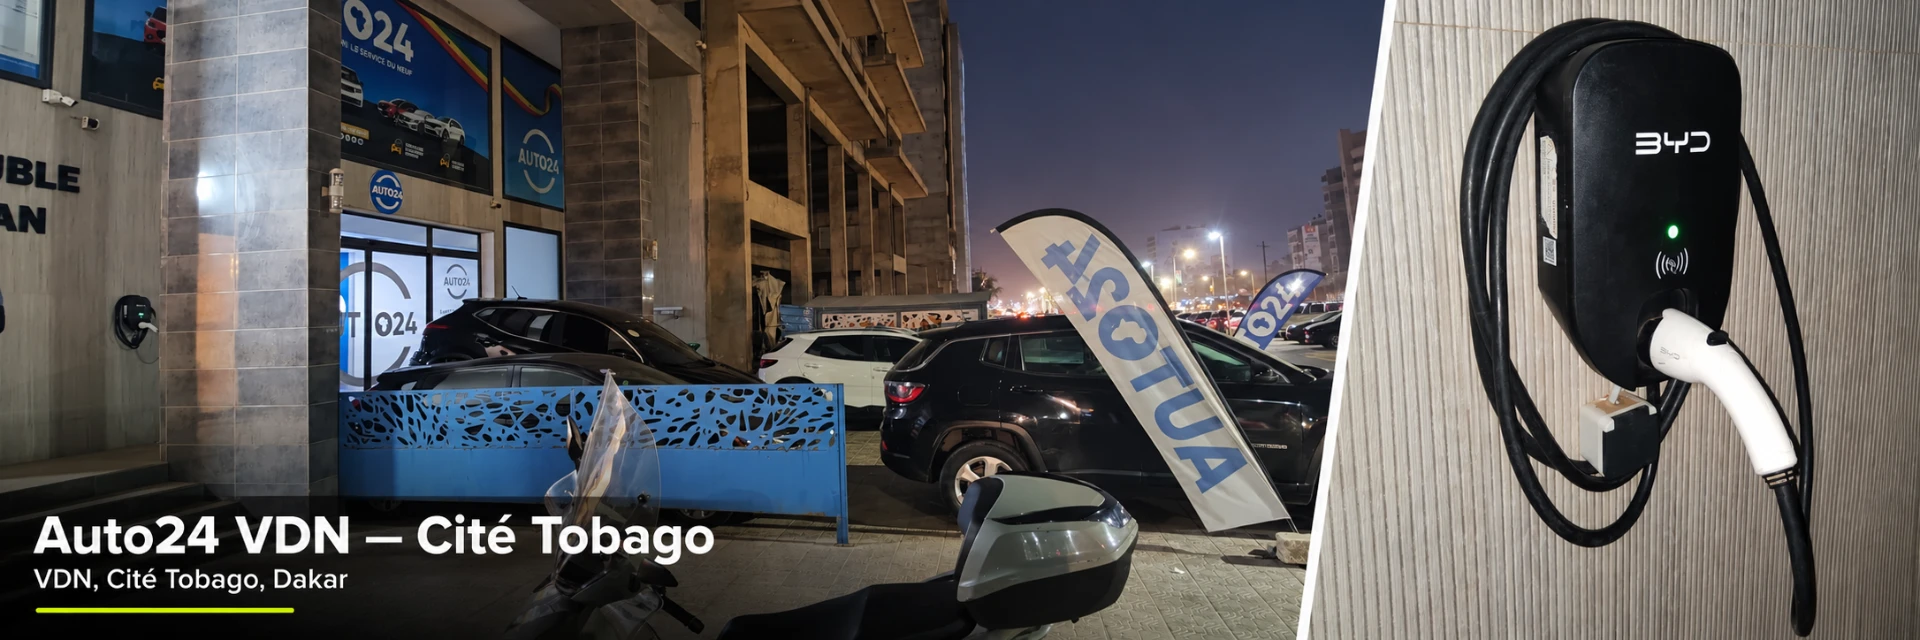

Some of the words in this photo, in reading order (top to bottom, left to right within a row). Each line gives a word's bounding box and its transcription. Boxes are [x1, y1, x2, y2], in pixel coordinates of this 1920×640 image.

[1635, 131, 1711, 155] BYD
[517, 147, 560, 176] AUTO24
[371, 184, 404, 201] AUTO24
[443, 277, 471, 286] AUTO24
